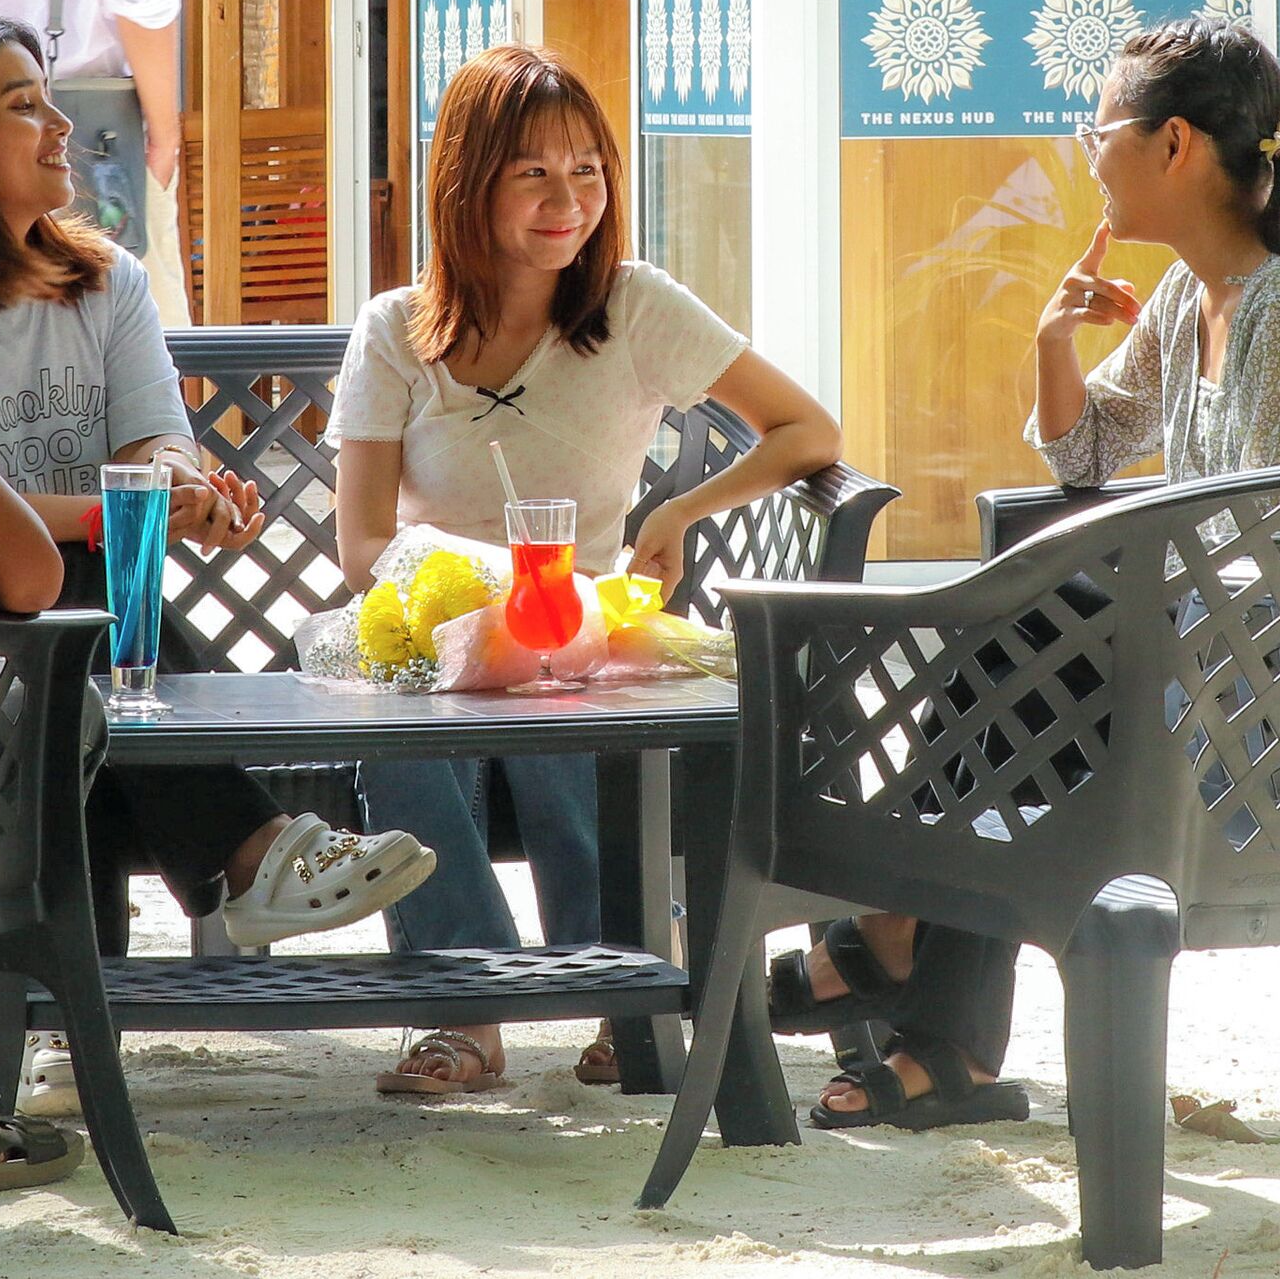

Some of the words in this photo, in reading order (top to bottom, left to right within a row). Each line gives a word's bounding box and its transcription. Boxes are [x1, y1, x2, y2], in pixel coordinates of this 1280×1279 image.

[860, 111, 893, 125] THE
[899, 111, 955, 125] NEXUS
[961, 110, 995, 124] HUB
[1022, 111, 1055, 124] THE
[1061, 111, 1094, 123] NEX
